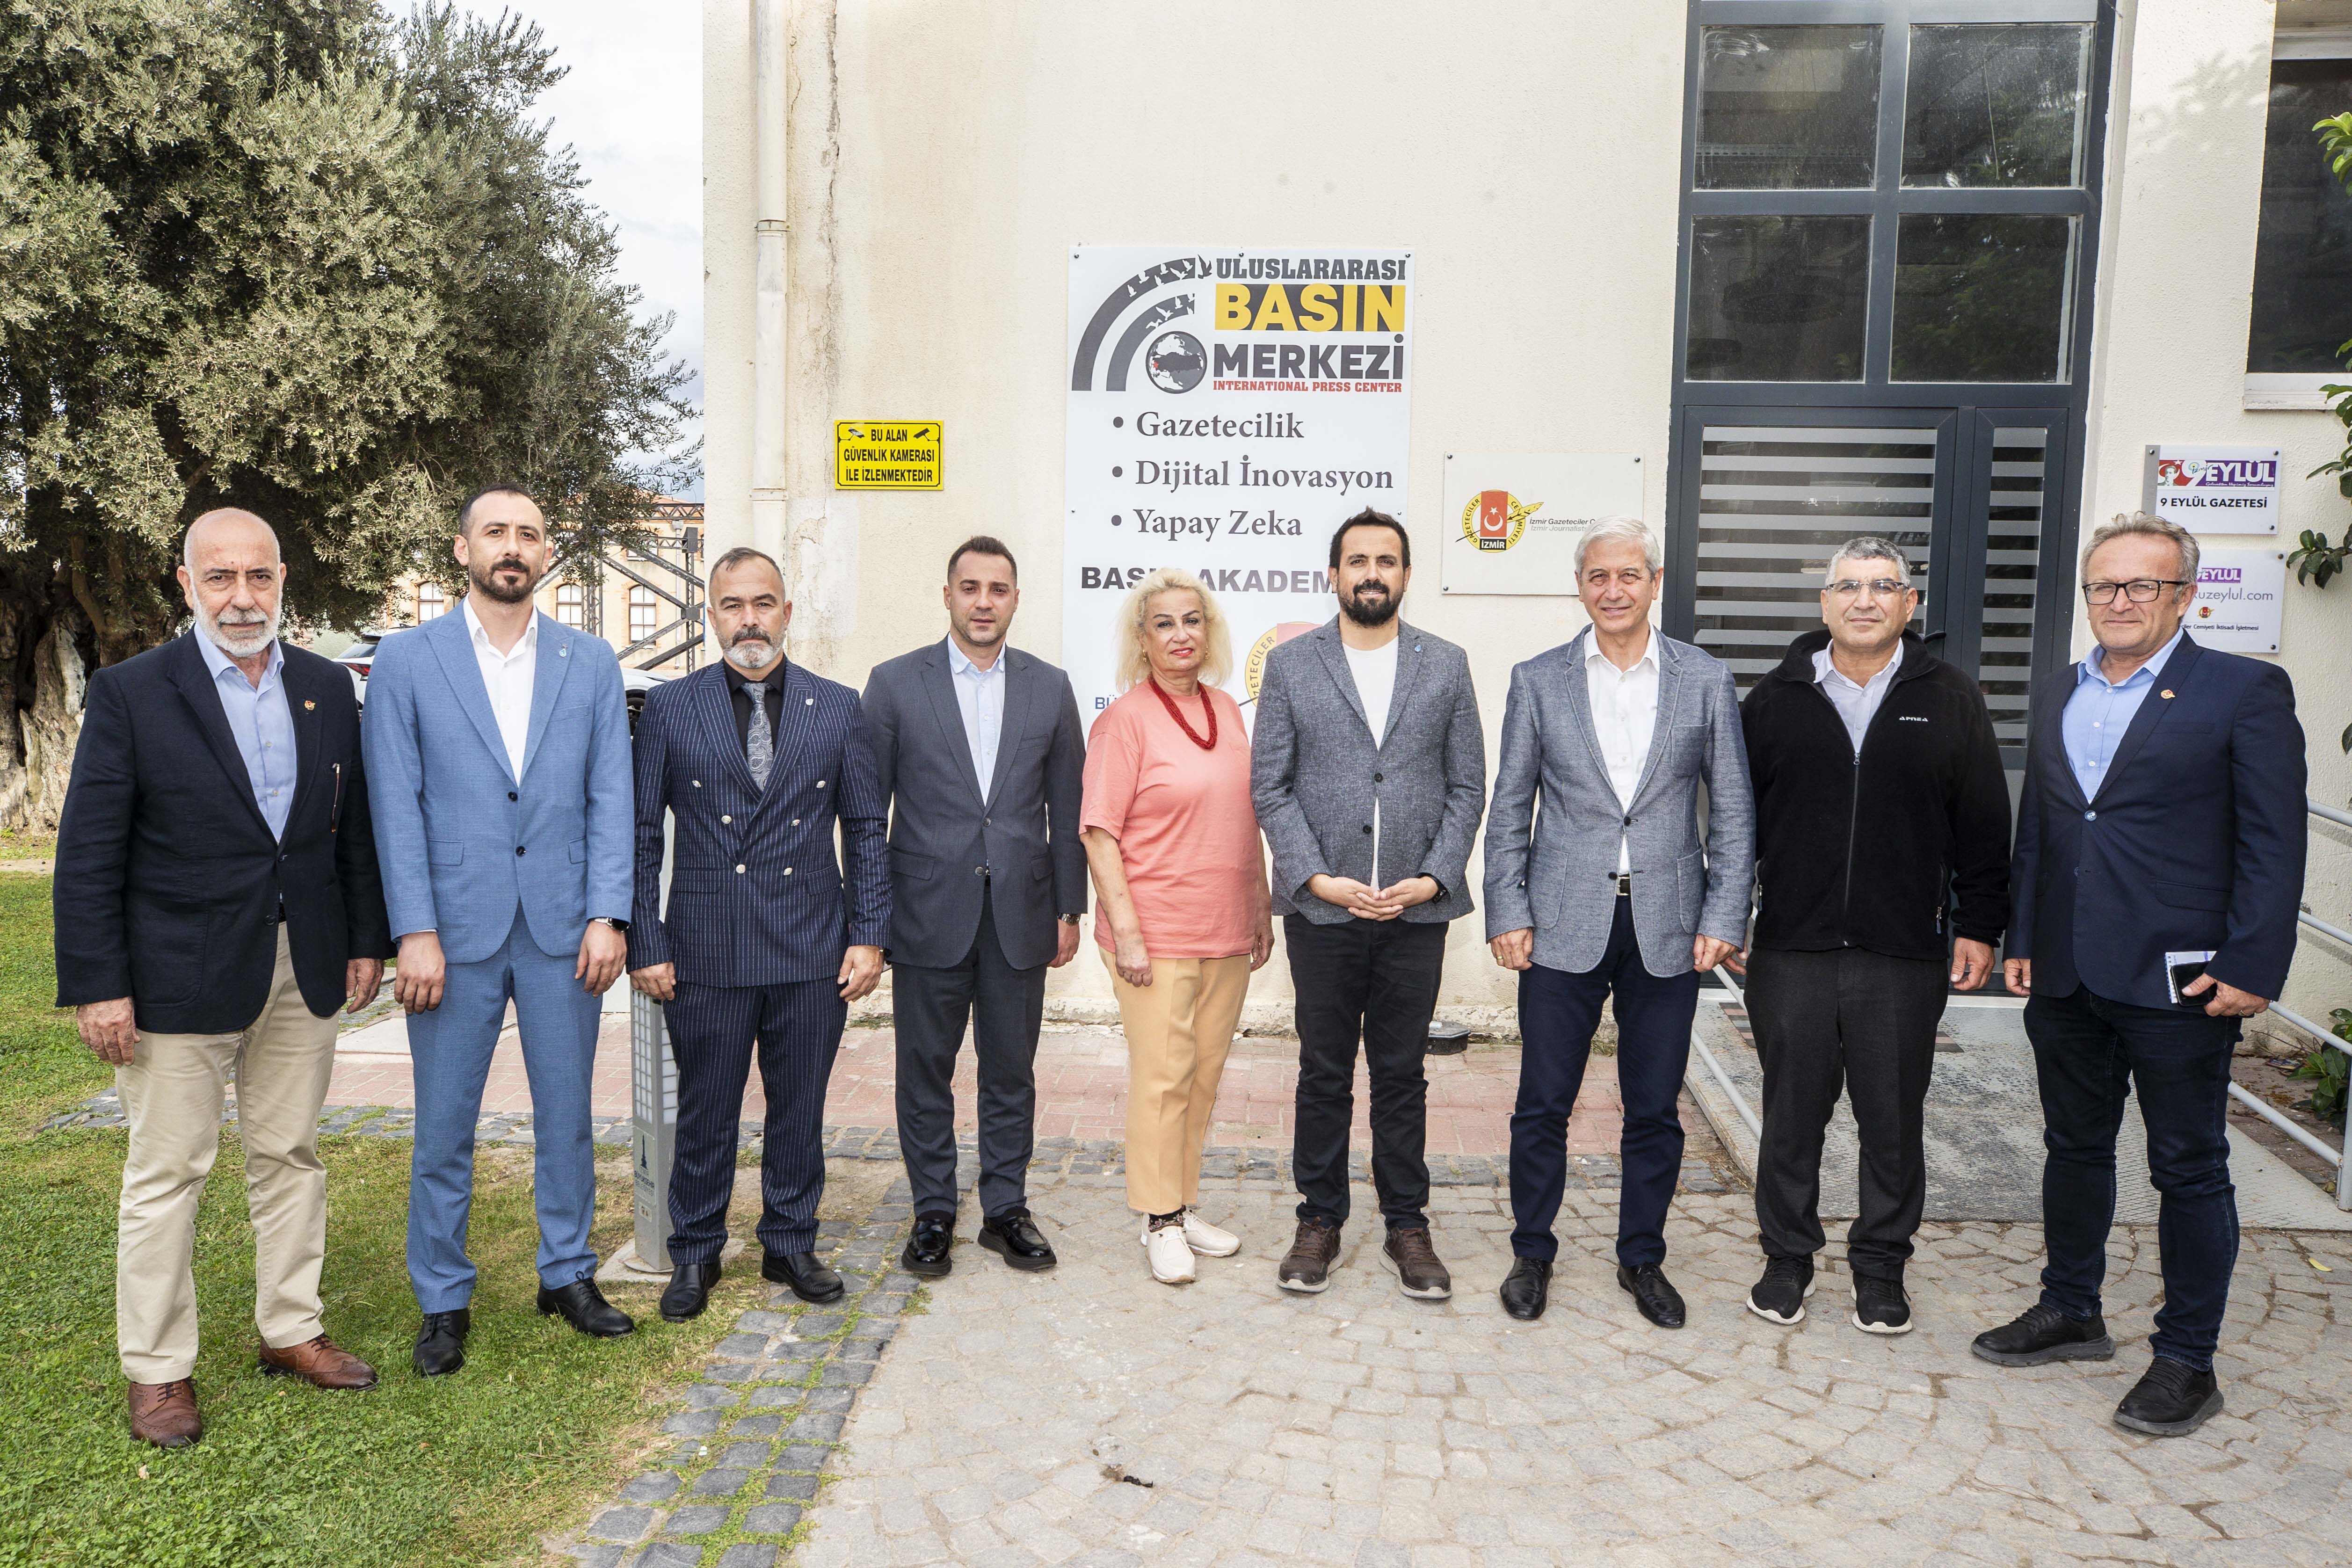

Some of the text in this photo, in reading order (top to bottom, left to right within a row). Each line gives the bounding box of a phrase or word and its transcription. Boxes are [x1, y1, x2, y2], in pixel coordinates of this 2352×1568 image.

[1216, 258, 1406, 280] ULUSLARARASI
[1215, 283, 1406, 332] BASIN
[1213, 334, 1404, 379] MERKEZİ
[1213, 380, 1402, 392] INTERNATIONAL PRESS CENTER
[871, 429, 907, 442] BU ALAN
[1136, 411, 1305, 438] Gazetecilik
[844, 446, 934, 462] GÜVENLİK KAMERASI
[846, 466, 933, 482] İLE İZLENMEKTEDİR
[1135, 454, 1394, 496] Dijital İnovasyon
[2206, 460, 2274, 482] EYLÜL
[2160, 496, 2267, 508] 9 EYLÜL GAZETESİ
[1133, 508, 1303, 542] Yapay Zeka
[1465, 499, 1480, 543] GAZETECİLER
[1481, 540, 1505, 549] İZMİR
[1082, 566, 1338, 594] BAS AKADEM
